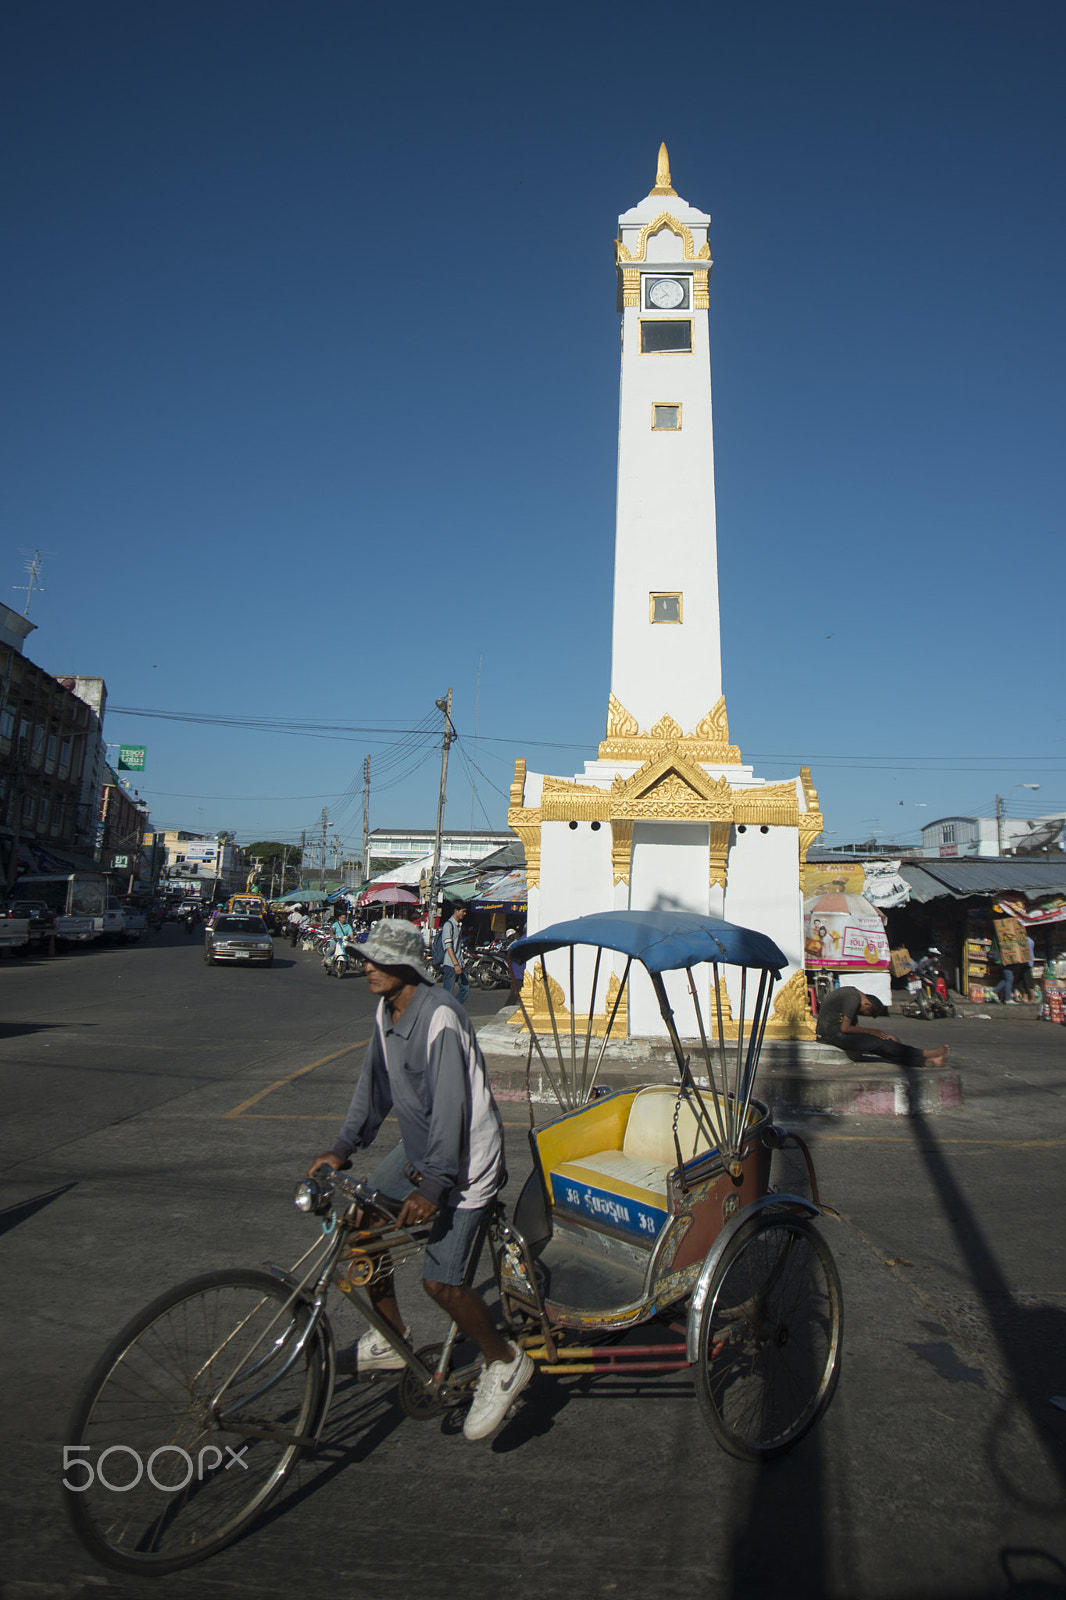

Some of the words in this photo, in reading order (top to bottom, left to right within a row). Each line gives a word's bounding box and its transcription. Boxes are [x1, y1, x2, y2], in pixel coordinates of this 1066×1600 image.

[120, 754, 144, 763] Lotus
[565, 1187, 580, 1206] 38
[637, 1212, 656, 1234] 38
